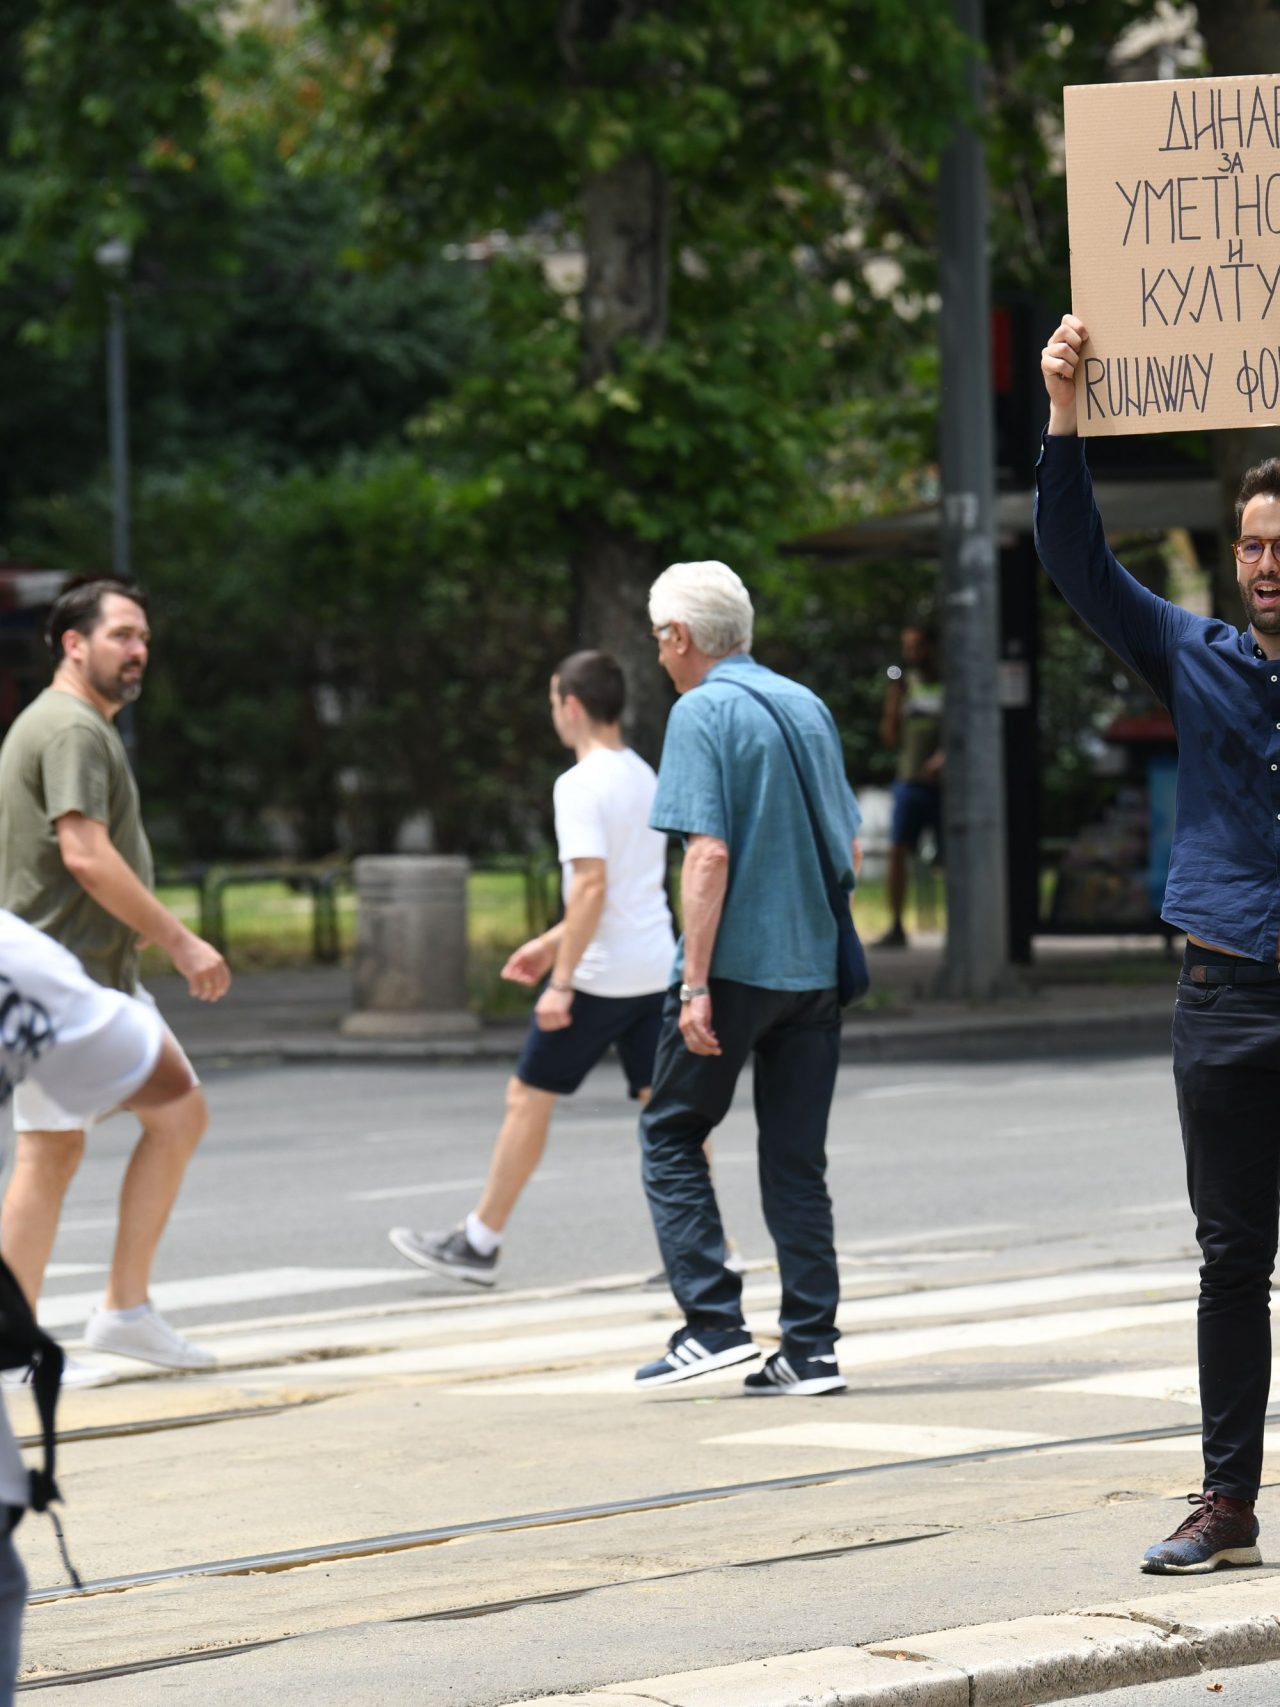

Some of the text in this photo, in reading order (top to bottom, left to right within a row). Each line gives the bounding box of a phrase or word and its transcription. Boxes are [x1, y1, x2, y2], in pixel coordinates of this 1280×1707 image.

[1217, 152, 1245, 174] ЗА
[1228, 239, 1244, 263] И
[1085, 352, 1214, 420] RUNAWAY
